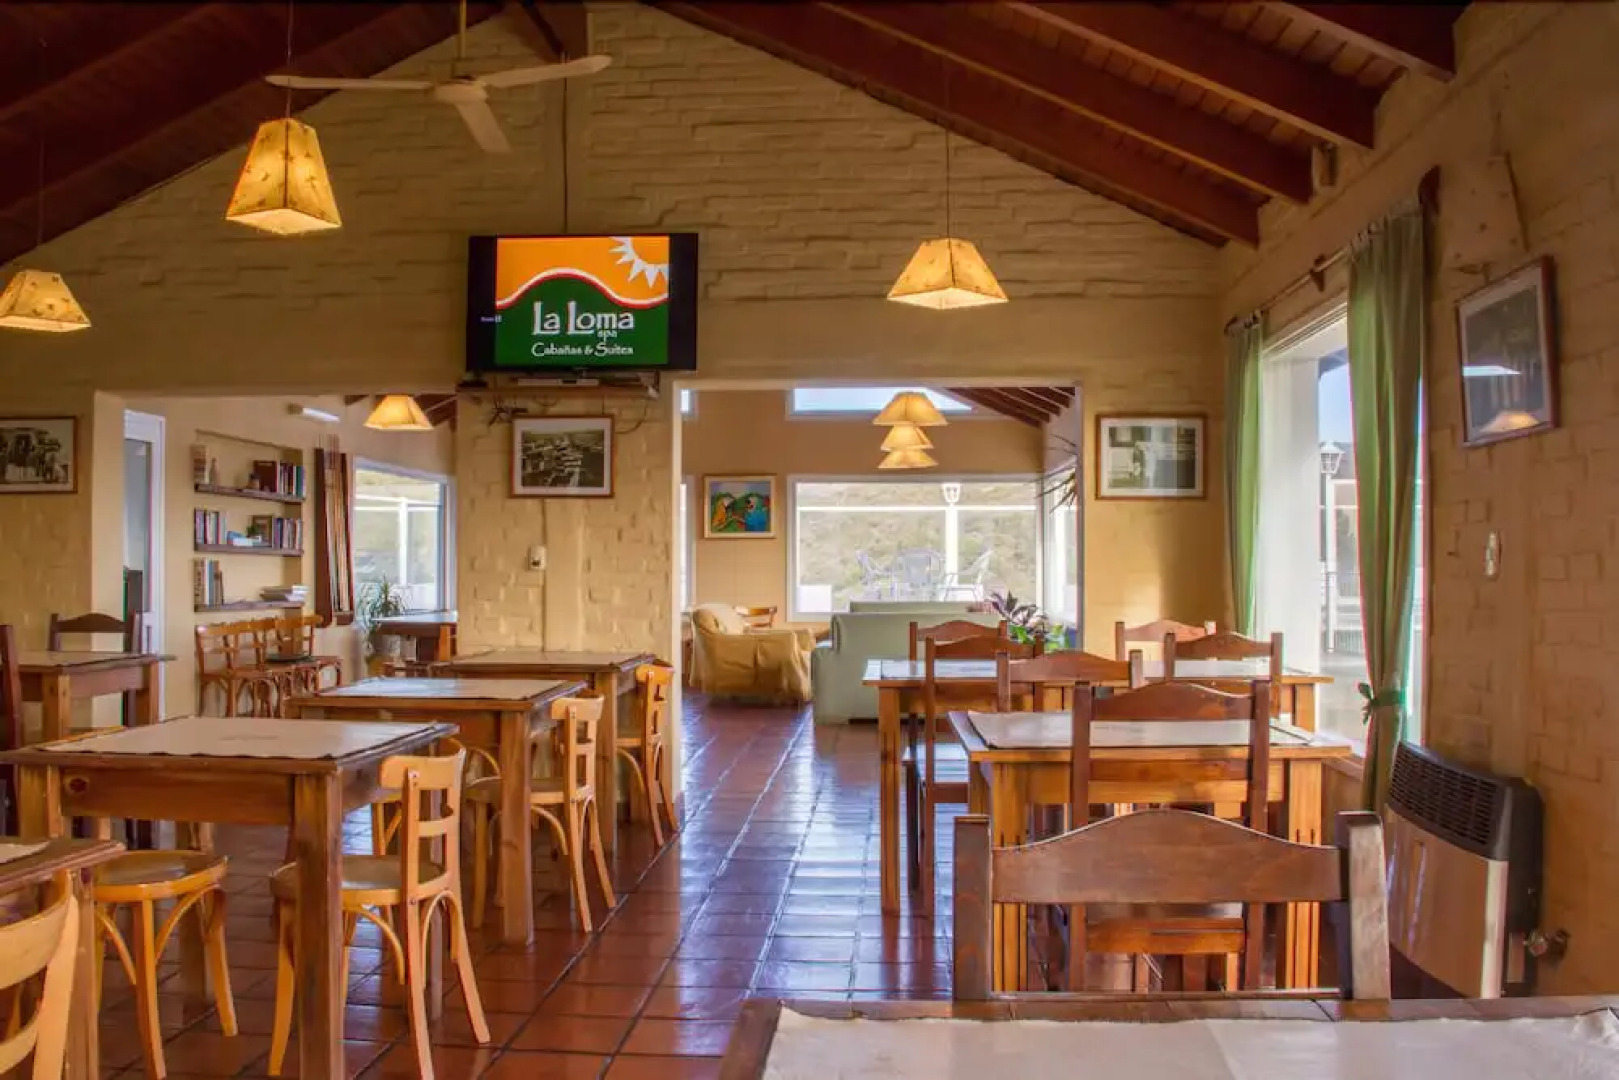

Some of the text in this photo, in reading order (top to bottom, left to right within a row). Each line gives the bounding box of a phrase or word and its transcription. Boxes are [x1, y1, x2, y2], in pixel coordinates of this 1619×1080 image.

[531, 301, 635, 335] La Loma
[531, 342, 634, 357] Cabañas & Suites
